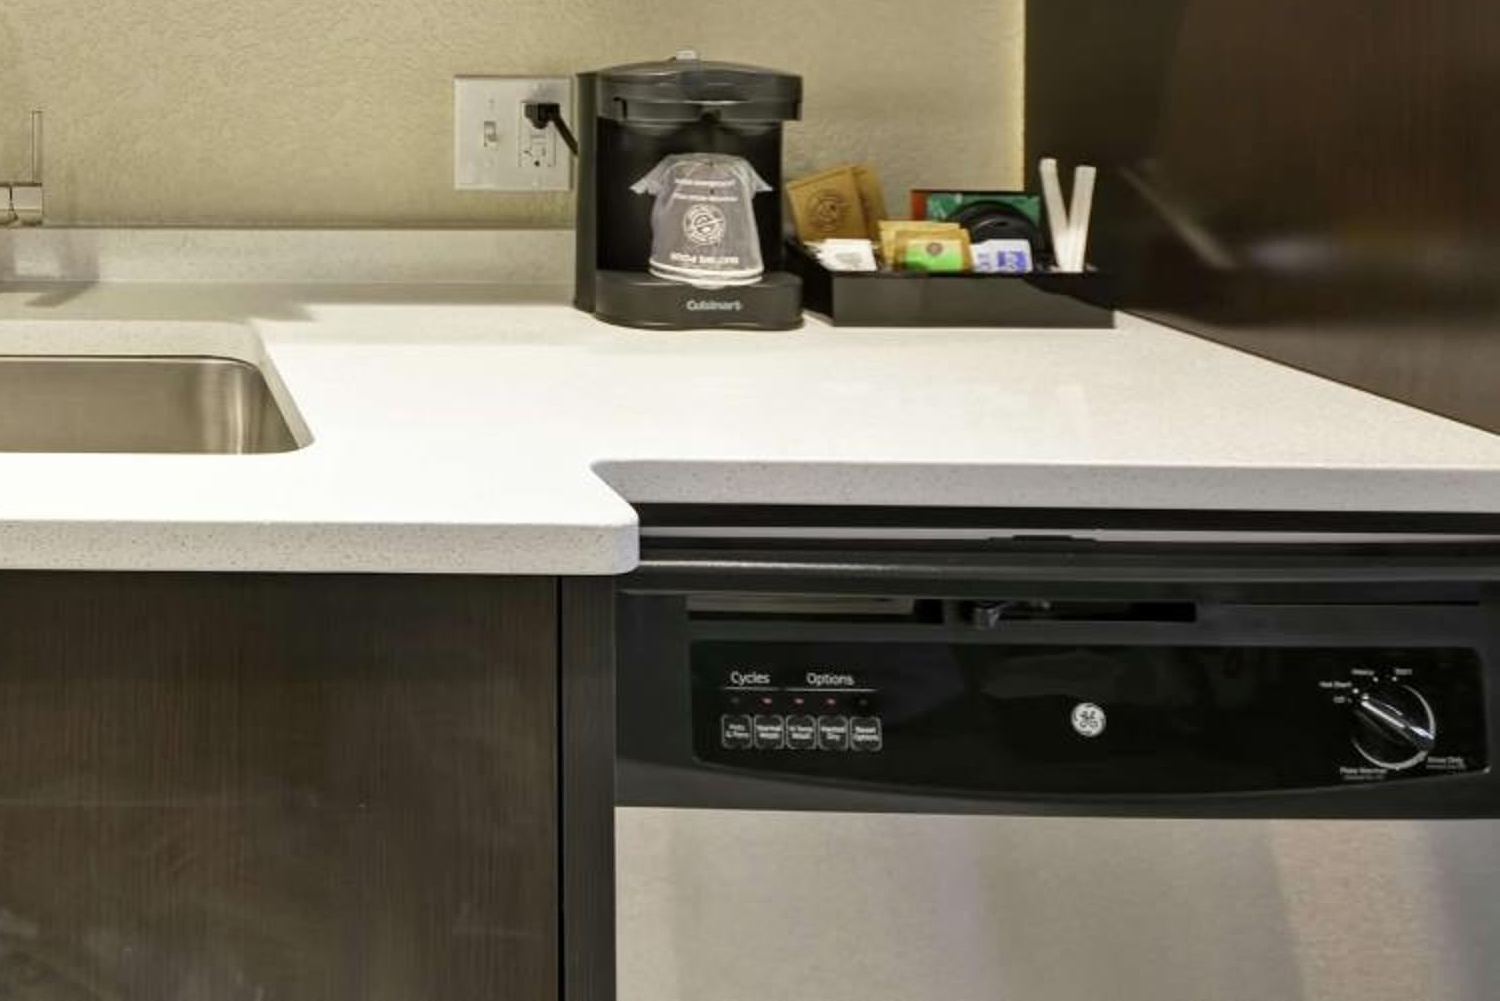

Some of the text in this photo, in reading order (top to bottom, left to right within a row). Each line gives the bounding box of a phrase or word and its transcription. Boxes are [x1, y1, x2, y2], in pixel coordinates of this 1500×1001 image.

[686, 300, 743, 312] Cuisinart
[730, 670, 771, 685] Cycles
[806, 672, 855, 686] Options
